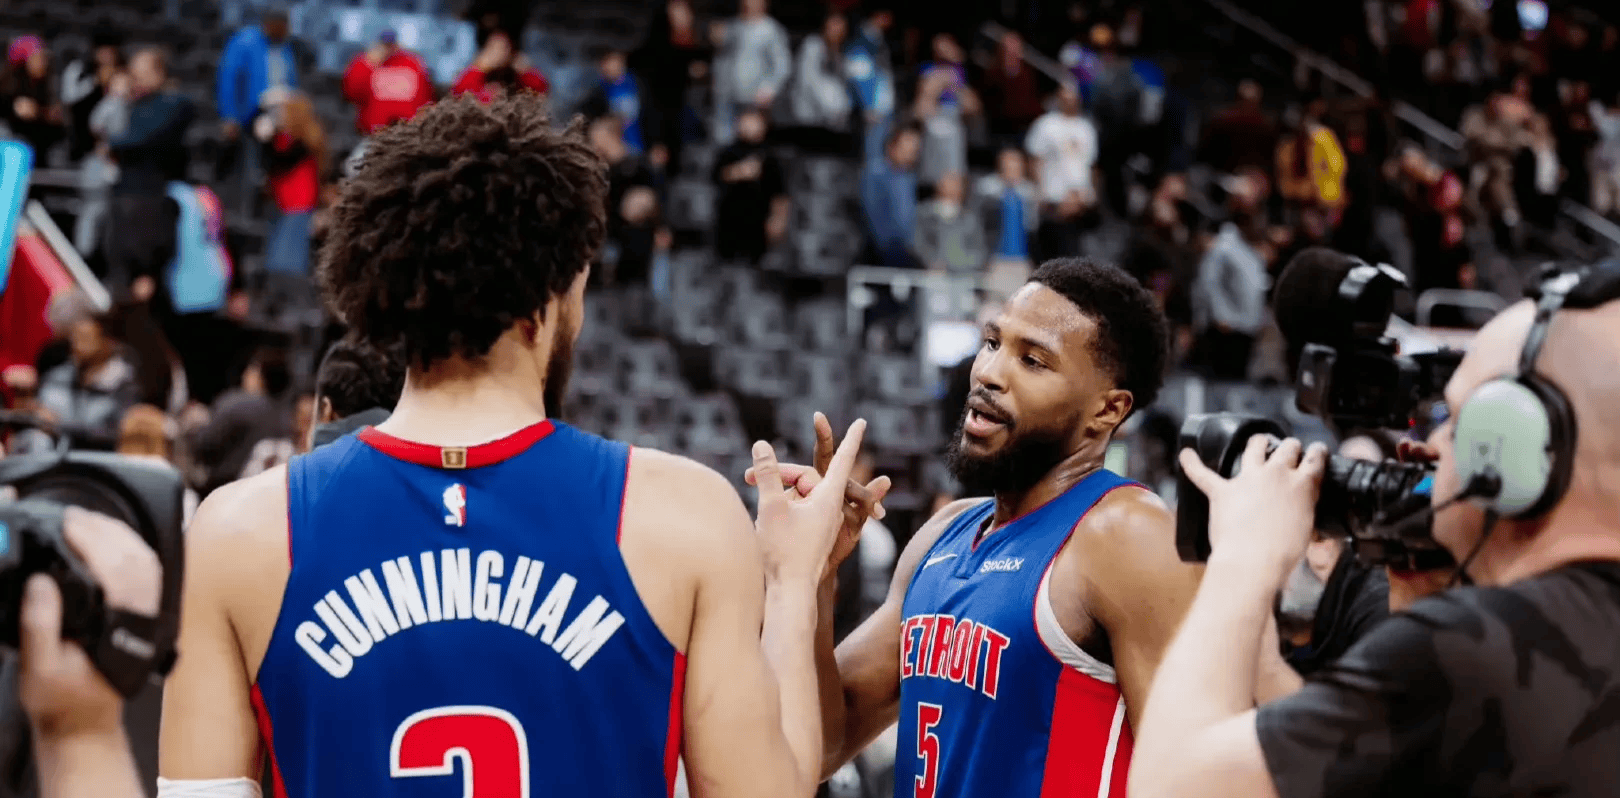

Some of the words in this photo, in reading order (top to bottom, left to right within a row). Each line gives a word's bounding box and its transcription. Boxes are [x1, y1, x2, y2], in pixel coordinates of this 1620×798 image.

[980, 557, 1025, 572] StockX
[294, 547, 626, 679] CUNNINGHAM
[900, 613, 1010, 700] ETROIT
[914, 701, 942, 798] 5
